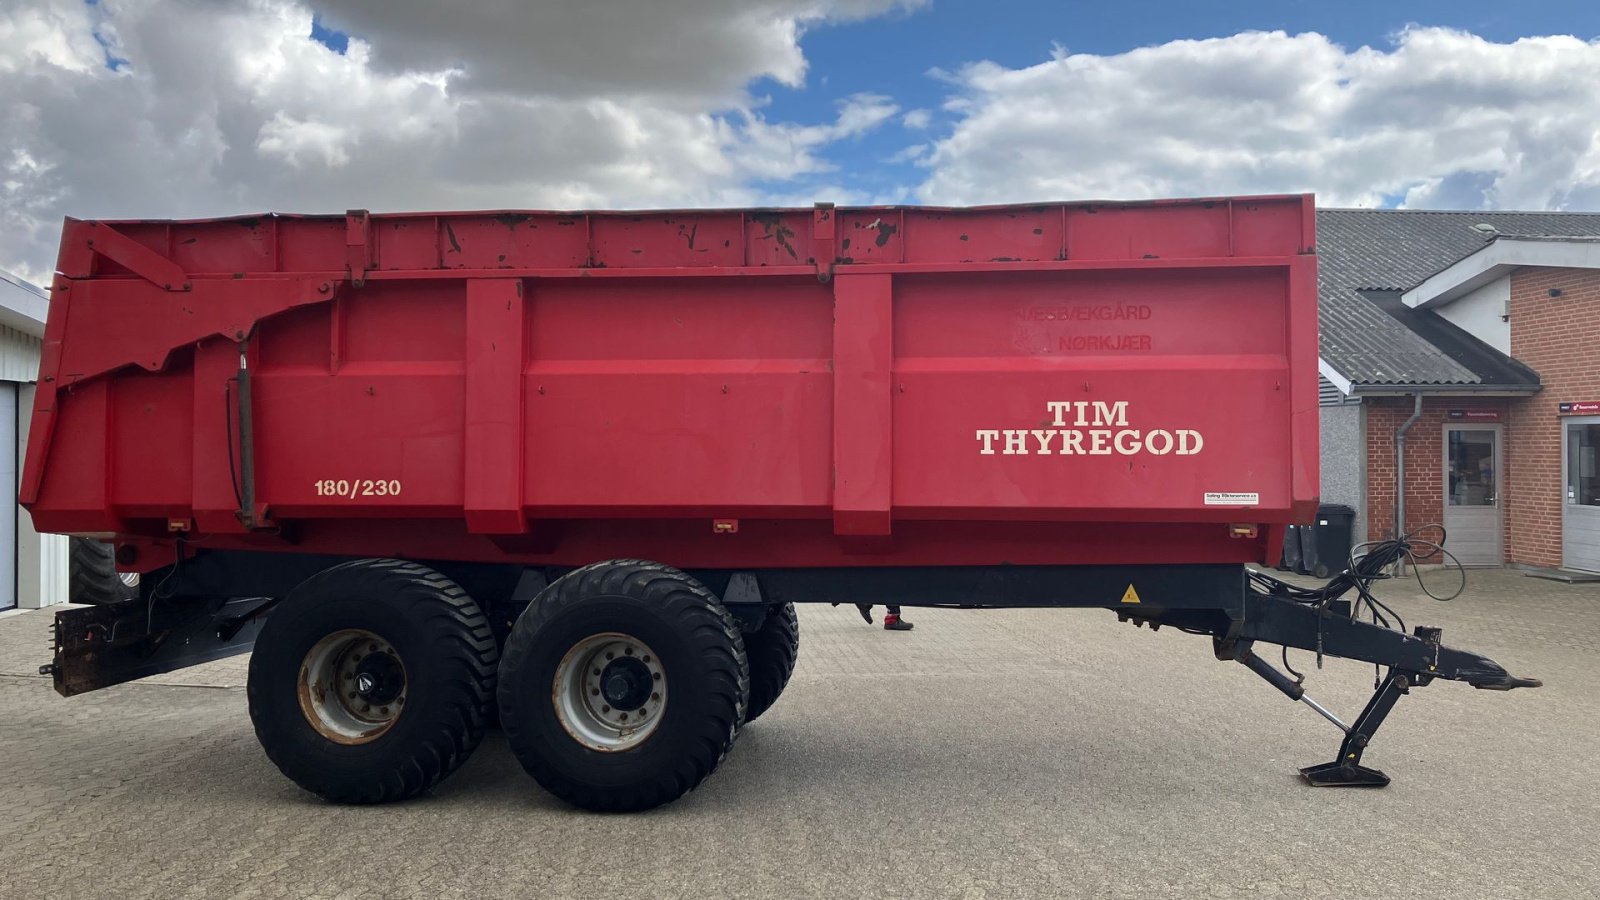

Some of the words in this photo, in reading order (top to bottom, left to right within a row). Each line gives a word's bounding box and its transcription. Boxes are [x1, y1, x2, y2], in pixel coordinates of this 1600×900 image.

[1058, 335, 1152, 351] NØRKJÆR
[1047, 401, 1129, 427] TIM
[976, 429, 1204, 456] THYREGOD
[314, 479, 401, 499] 180/230
